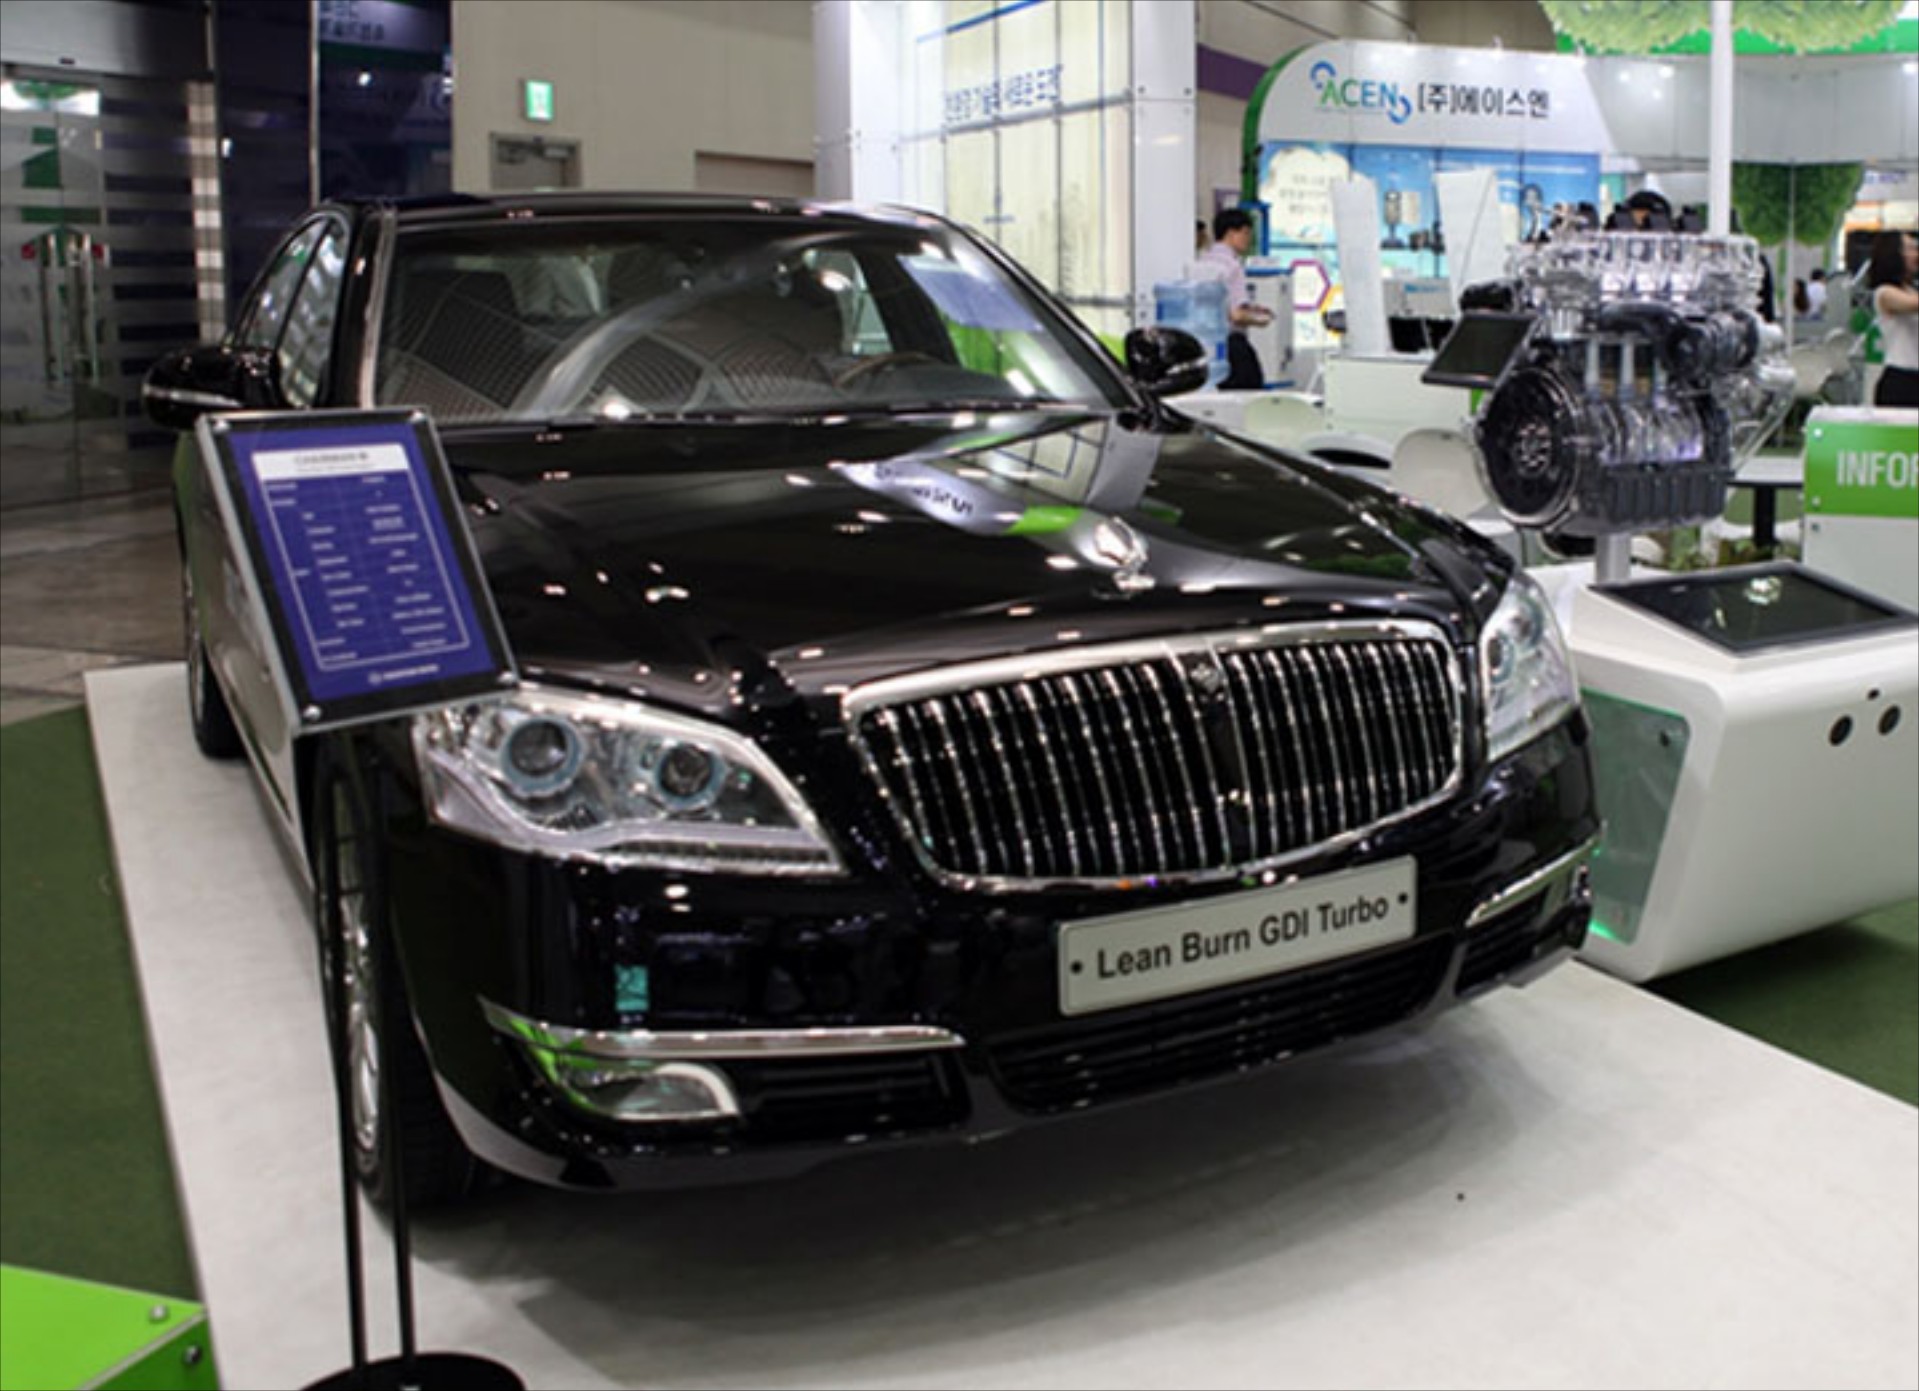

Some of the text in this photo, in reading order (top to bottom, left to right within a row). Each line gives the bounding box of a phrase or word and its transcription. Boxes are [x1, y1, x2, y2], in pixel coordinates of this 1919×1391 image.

[1320, 79, 1398, 108] ACEN
[1097, 895, 1390, 979] Lean Burn GDI Turbo
